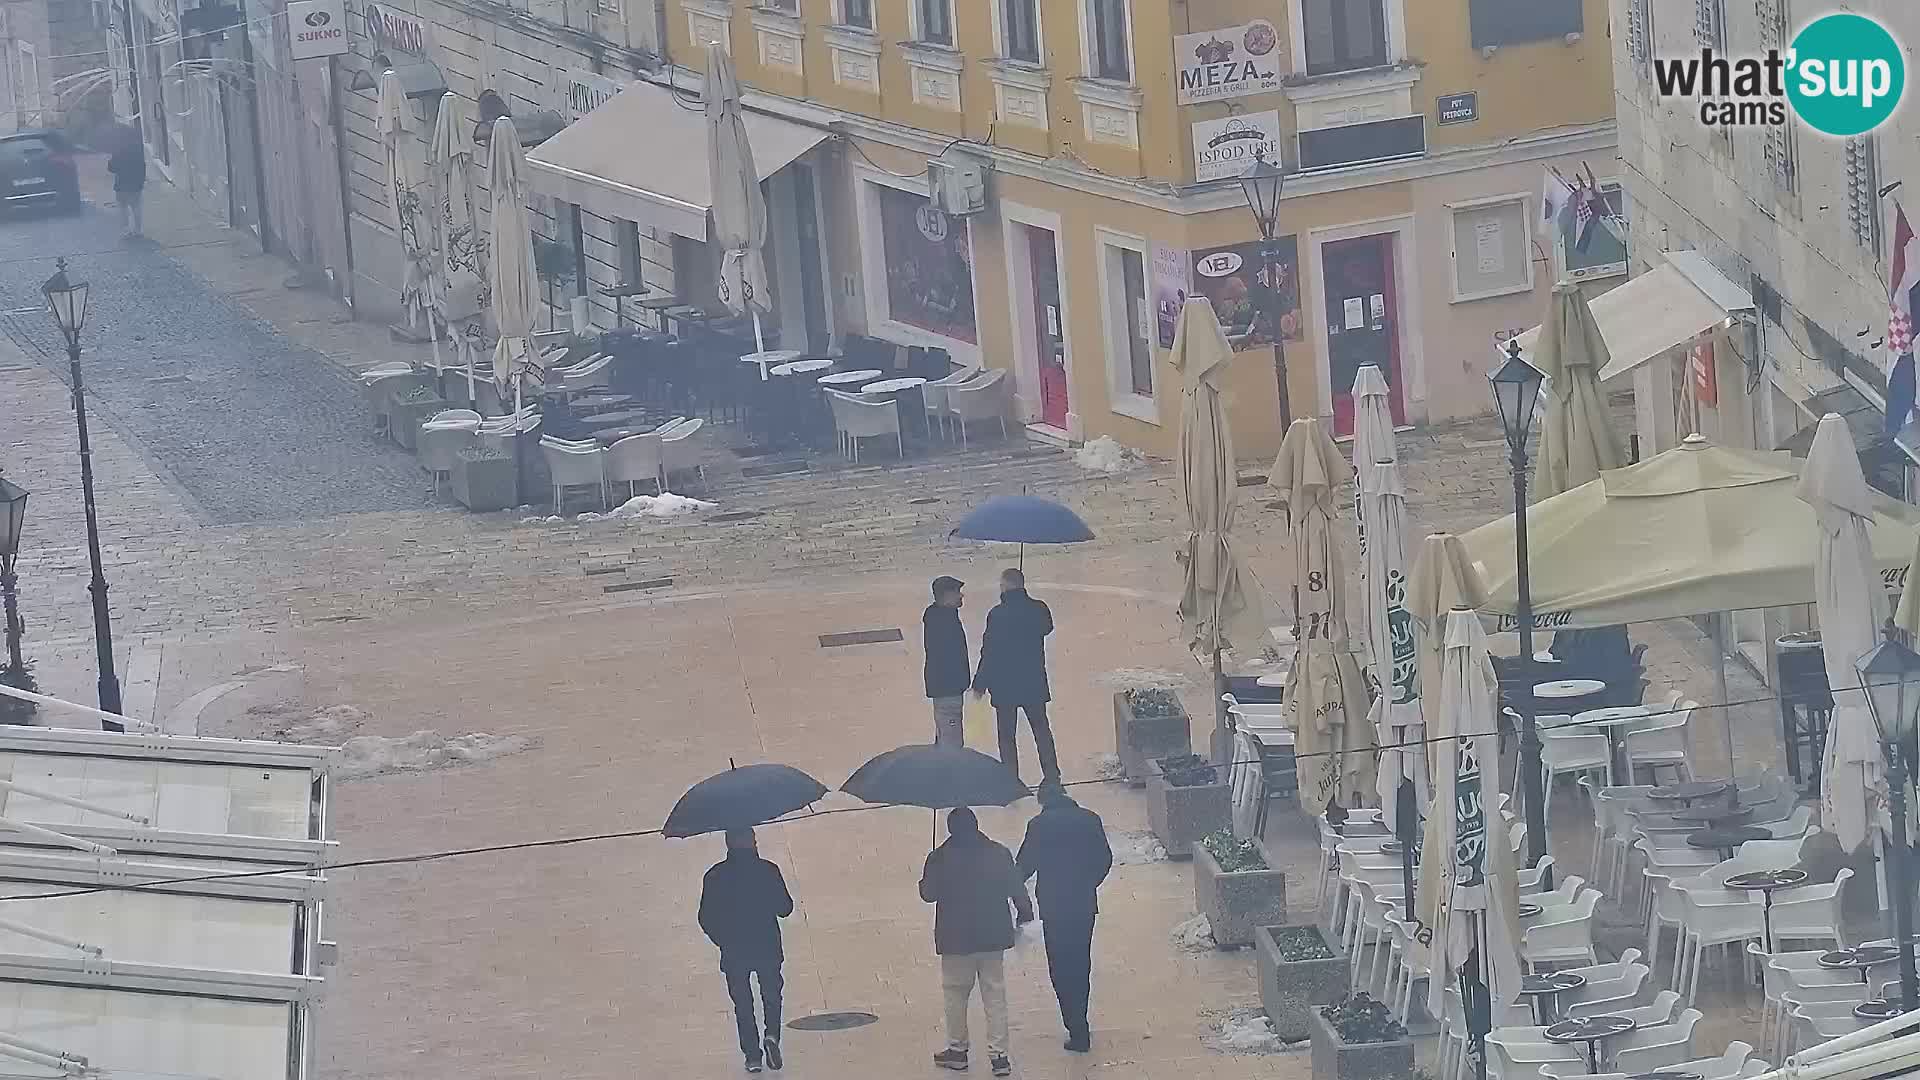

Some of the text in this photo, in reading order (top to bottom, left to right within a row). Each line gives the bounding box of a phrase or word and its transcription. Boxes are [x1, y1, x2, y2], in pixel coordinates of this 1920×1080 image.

[297, 28, 342, 42] SUKNO
[383, 13, 424, 52] SUKNO
[1180, 60, 1260, 90] MEZA
[1199, 145, 1245, 164] ISPOD
